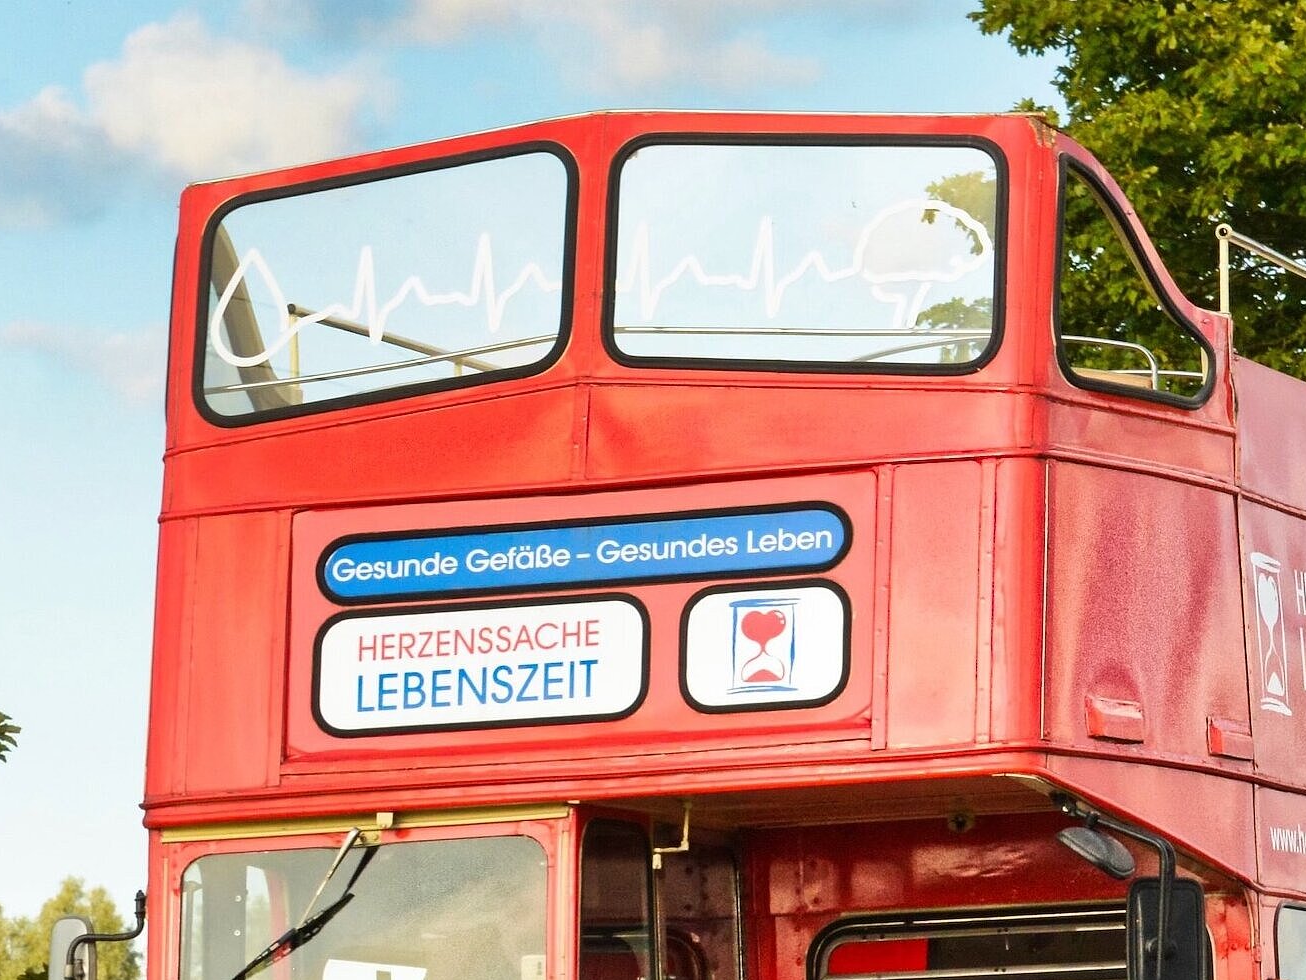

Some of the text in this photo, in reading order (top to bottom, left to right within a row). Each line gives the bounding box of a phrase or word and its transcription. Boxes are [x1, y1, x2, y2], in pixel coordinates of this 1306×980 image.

[331, 552, 459, 583] Gesunde
[465, 544, 572, 574] Gefäße
[595, 533, 739, 565] Gesundes
[746, 527, 833, 555] Leben
[358, 619, 600, 662] HERZENSSACHE
[356, 659, 599, 713] LEBENSZEIT
